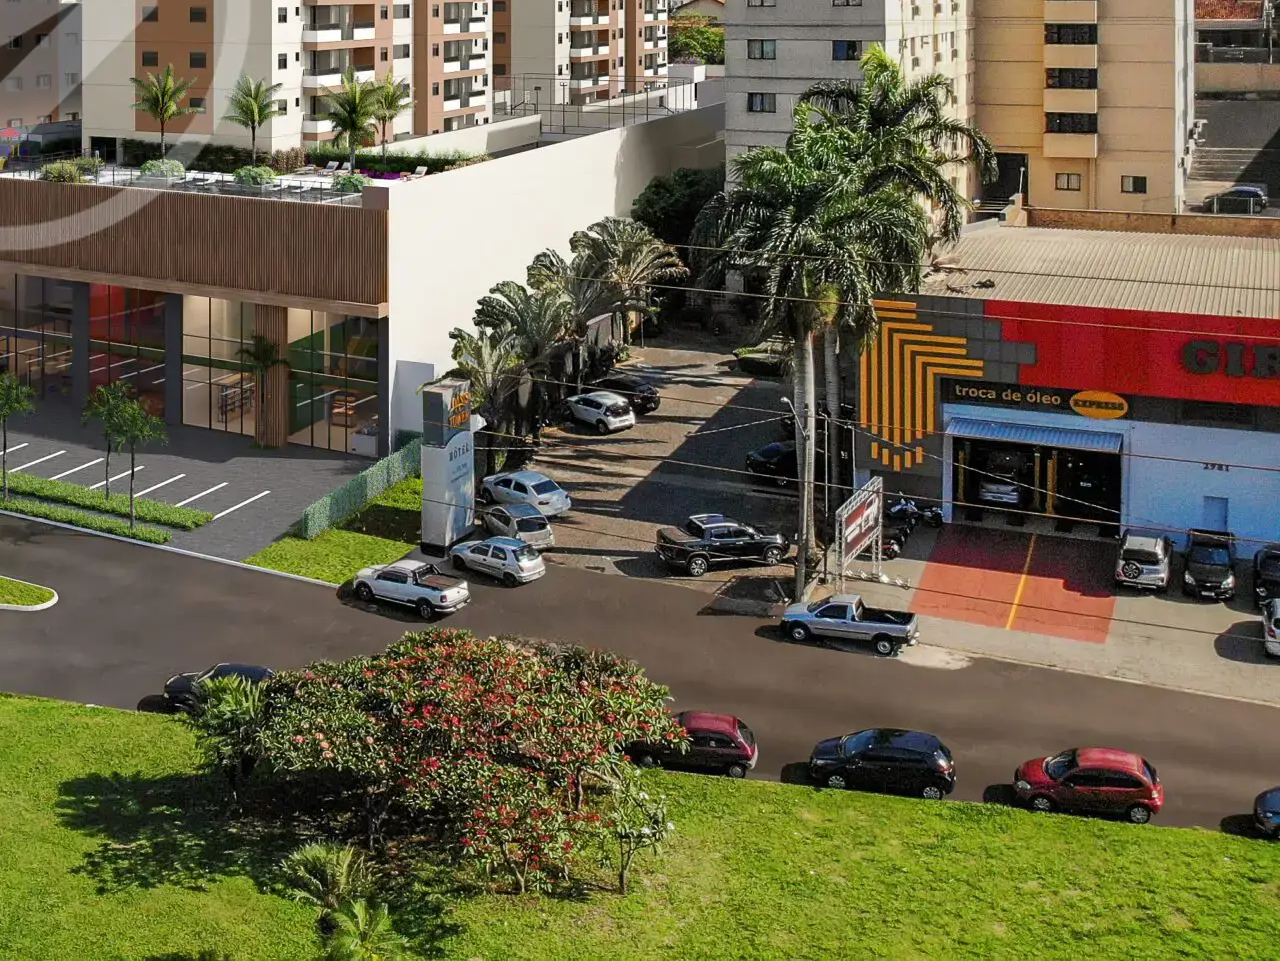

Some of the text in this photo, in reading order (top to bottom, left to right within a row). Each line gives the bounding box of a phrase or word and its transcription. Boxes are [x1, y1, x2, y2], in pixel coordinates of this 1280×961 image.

[955, 385, 1061, 405] troca de óleo
